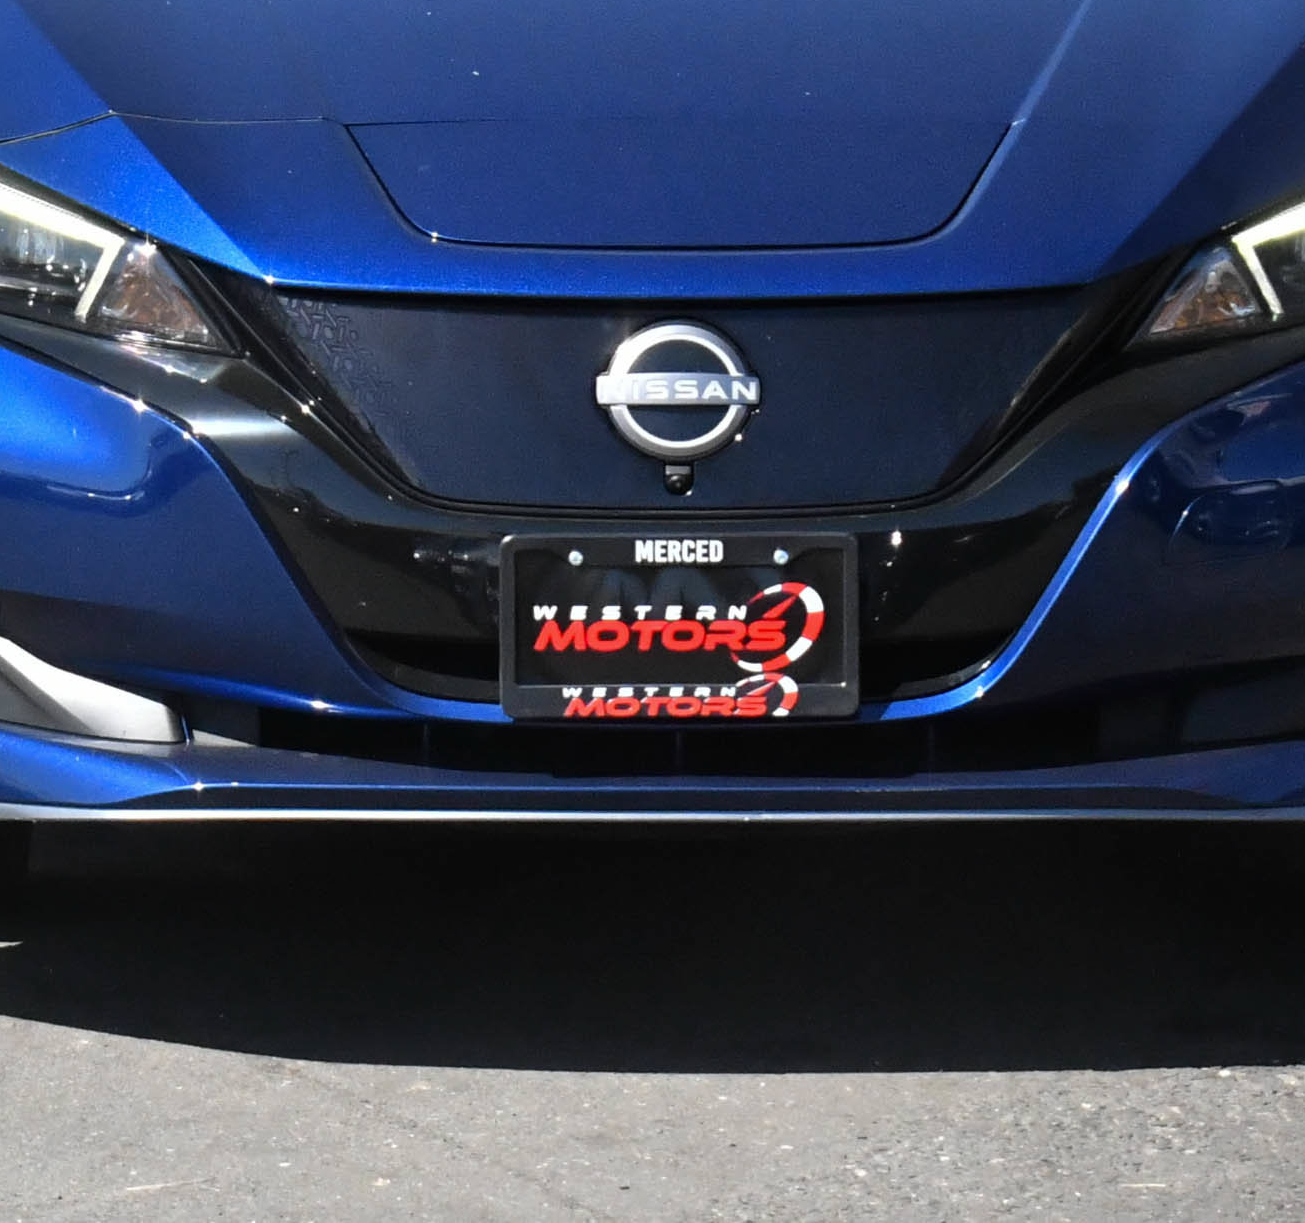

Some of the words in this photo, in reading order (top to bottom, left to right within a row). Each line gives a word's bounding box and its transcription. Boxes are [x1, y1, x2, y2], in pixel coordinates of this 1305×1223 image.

[600, 379, 757, 401] NISSAN
[635, 540, 724, 563] MERCED
[533, 604, 748, 621] WESTERN
[533, 619, 787, 652] MOTORS
[562, 686, 737, 698] WESTERN
[563, 695, 769, 718] MOTORS
